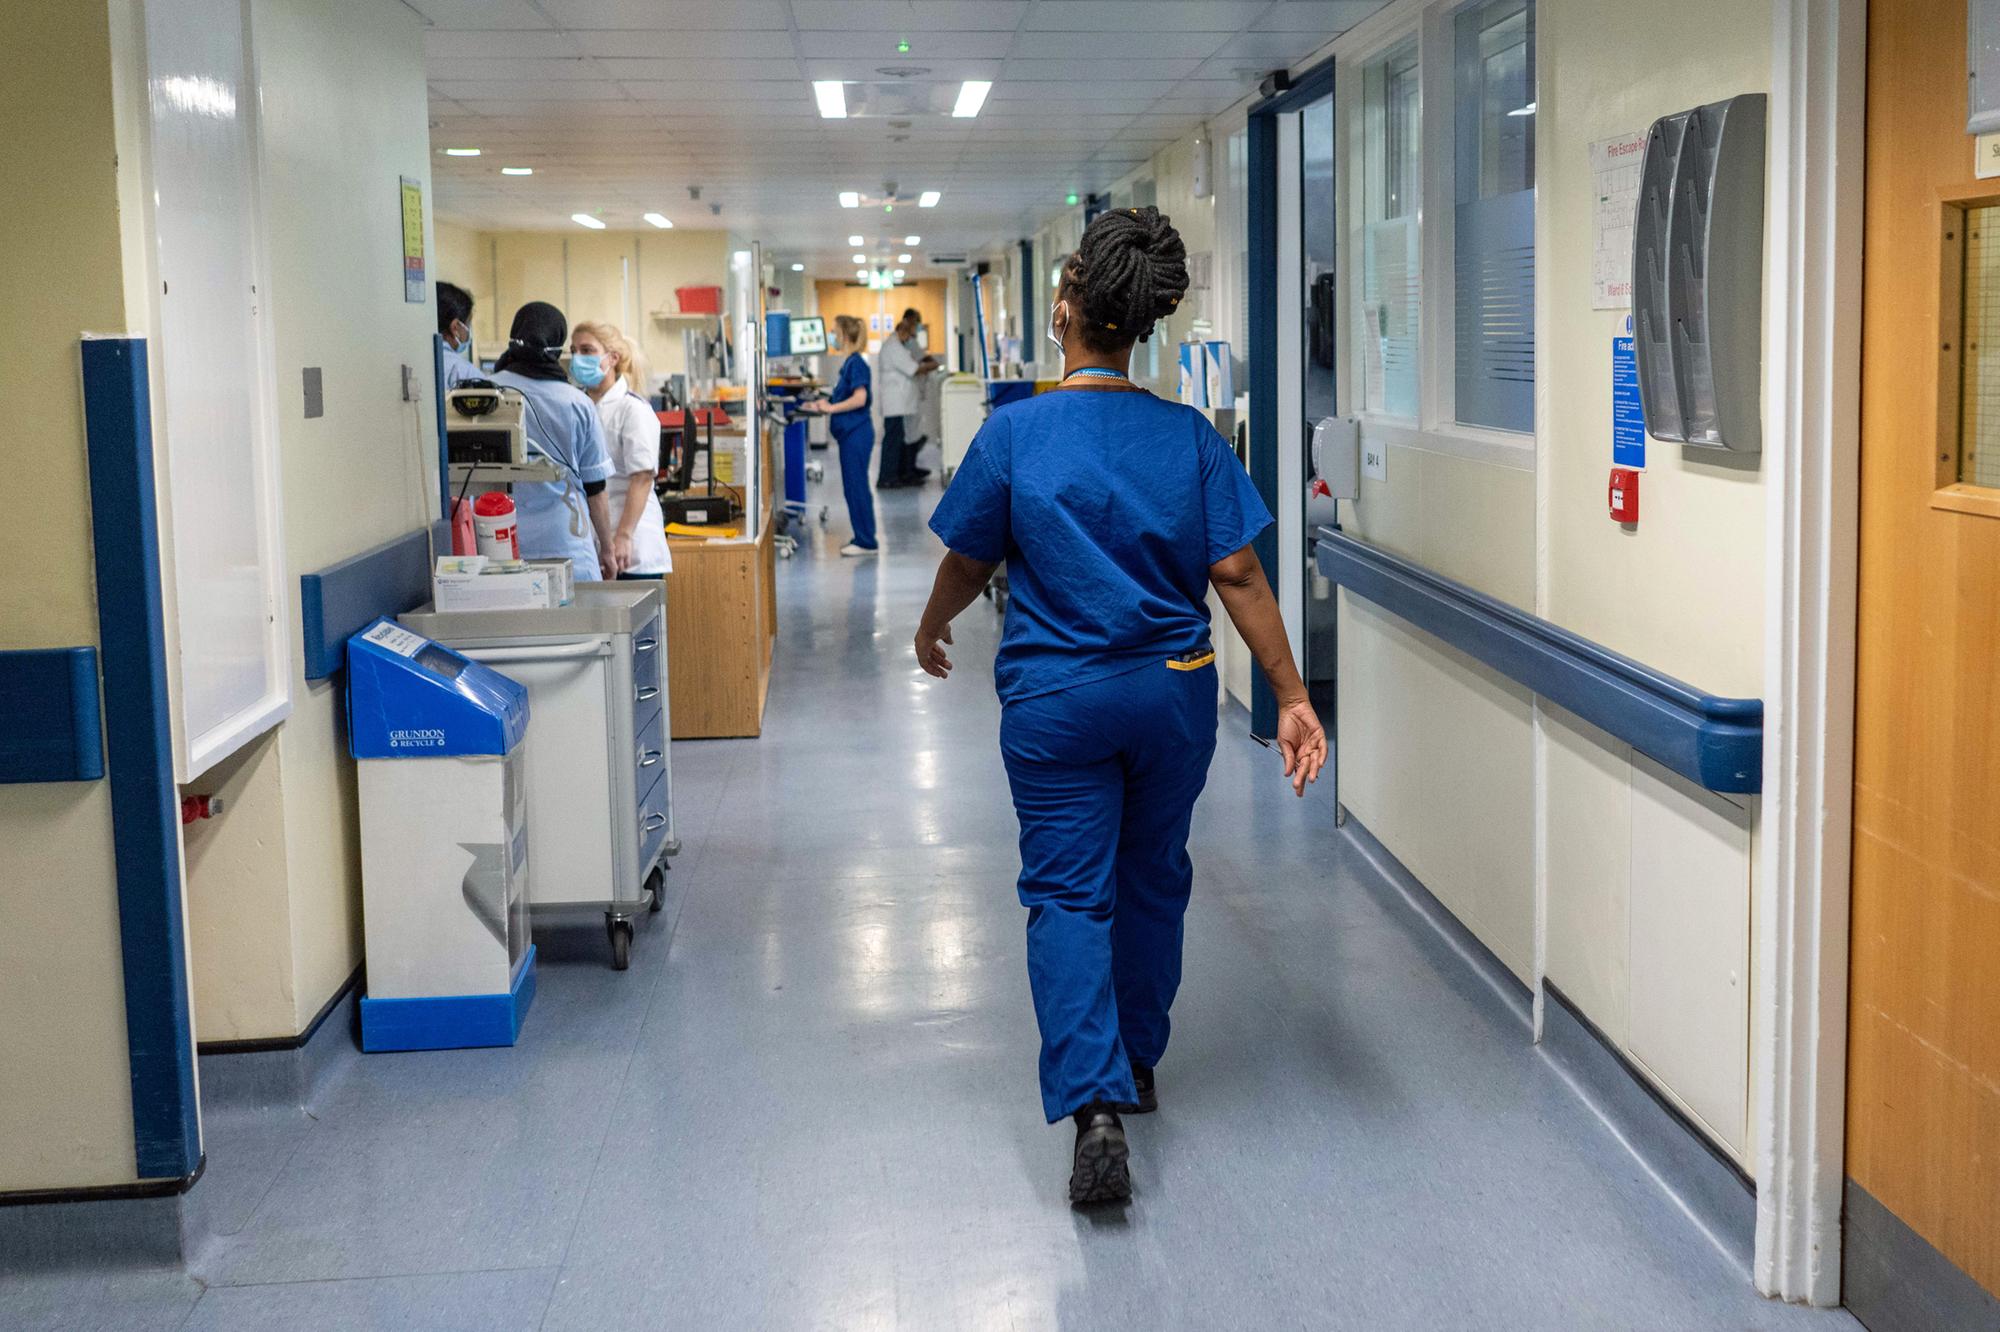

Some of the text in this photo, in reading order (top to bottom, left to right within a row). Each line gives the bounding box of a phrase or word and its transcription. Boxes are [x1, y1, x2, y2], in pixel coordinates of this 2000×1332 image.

[1608, 144, 1618, 158] Fire
[1619, 142, 1637, 157] Escape
[1618, 340, 1627, 350] Fire
[390, 729, 445, 738] GRUNDON
